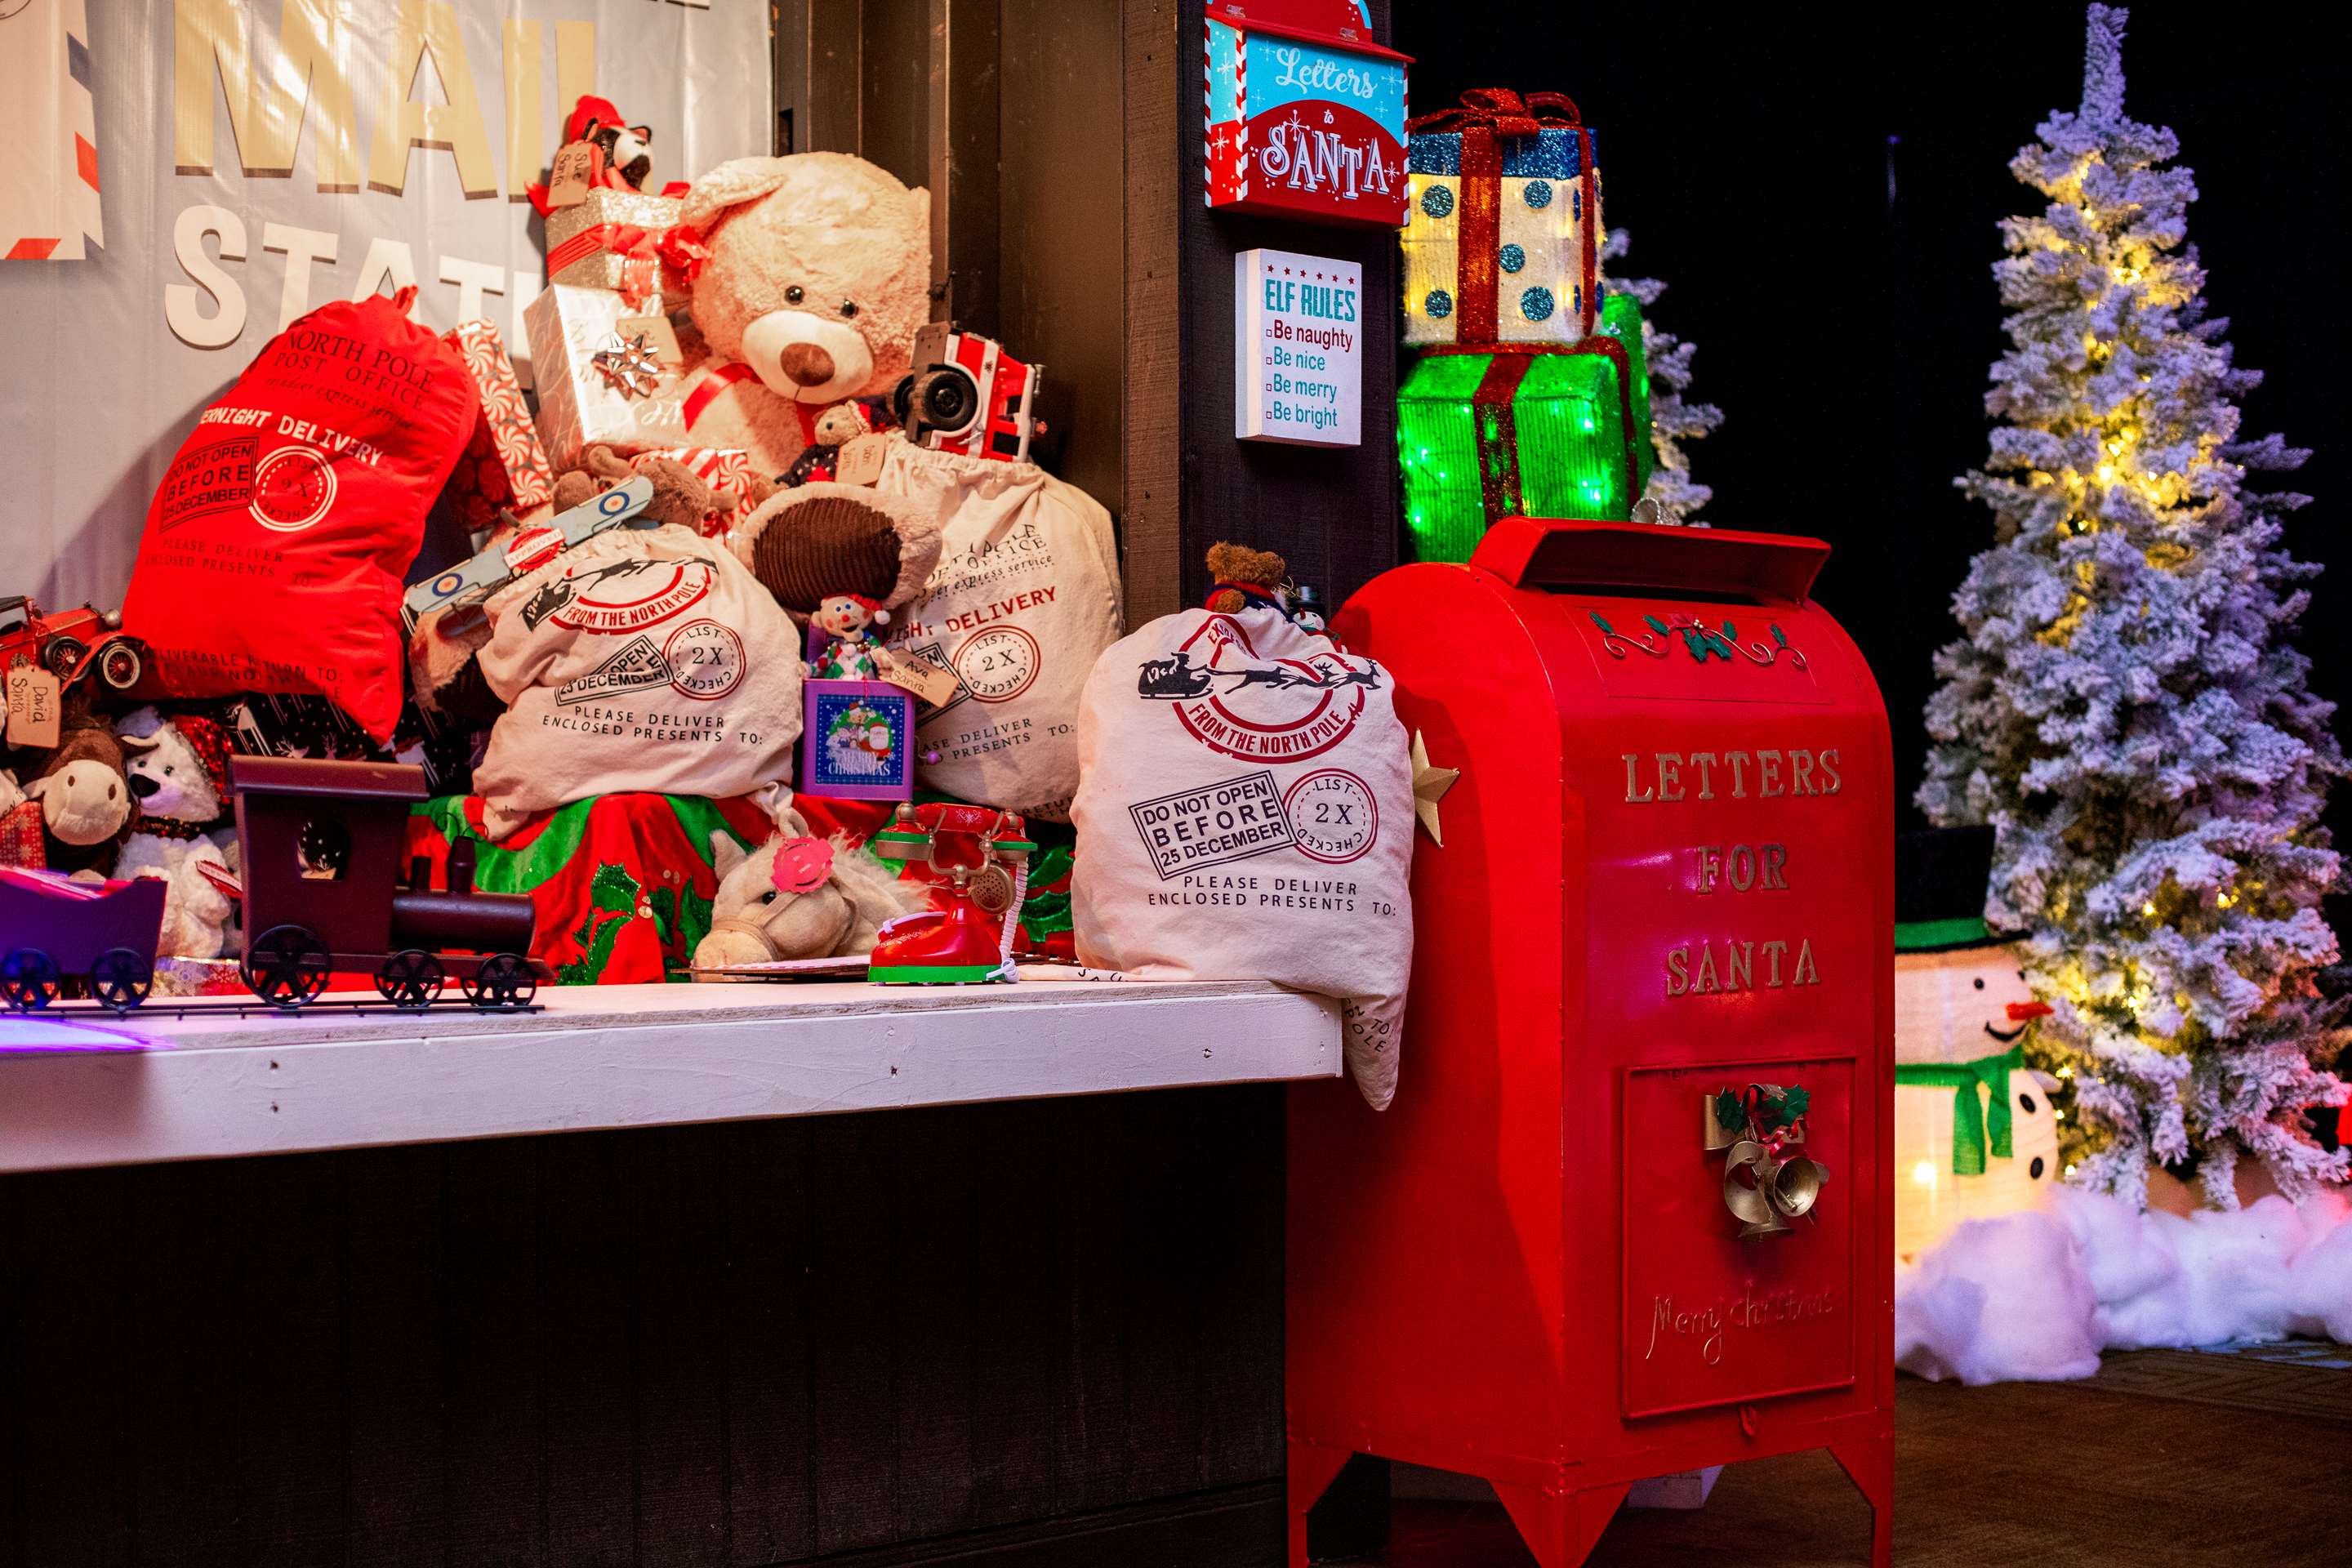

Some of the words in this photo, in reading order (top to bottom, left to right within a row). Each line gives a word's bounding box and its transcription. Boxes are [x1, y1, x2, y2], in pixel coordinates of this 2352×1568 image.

[1276, 47, 1378, 98] Letters
[1324, 109, 1334, 124] to
[1259, 125, 1389, 199] SANTA
[1266, 279, 1295, 313] ELF
[1301, 284, 1356, 322] RULES
[1274, 319, 1292, 341] Be
[1296, 327, 1352, 353] naughty
[283, 330, 366, 362] NORTH
[372, 349, 435, 394] POLE
[1274, 346, 1291, 366] Be
[1296, 350, 1325, 371] nice
[274, 352, 327, 372] POST
[345, 367, 423, 412] OFFICE
[1274, 373, 1290, 394] Be
[1295, 382, 1337, 403] merry
[1274, 401, 1291, 421] Be
[1295, 403, 1338, 430] bright
[277, 415, 385, 466] DELIVERY
[185, 452, 209, 471] NOT
[211, 444, 252, 463] OPEN
[167, 465, 249, 501] BEFORE
[175, 488, 250, 515] DECEMBER
[163, 537, 204, 552] PLEASE
[216, 544, 283, 563] DELIVER
[1008, 555, 1053, 573] service
[202, 559, 274, 577] PRESENTS
[563, 606, 596, 626] FROM
[601, 611, 626, 626] THE
[629, 599, 674, 624] NORTH
[674, 581, 700, 604] POLE
[946, 586, 1056, 632] DELIVERY
[686, 626, 720, 638] LIST
[976, 635, 1008, 649] LIST
[577, 670, 665, 691] DECEMBER
[676, 671, 731, 689] CHECKED
[905, 661, 928, 680] Ava
[973, 667, 1027, 693] CHECKED
[11, 678, 28, 715] Santa
[33, 686, 48, 723] David
[542, 715, 623, 735] ENCLOSED
[634, 727, 723, 742] PRESENTS
[740, 732, 763, 745] TO:
[575, 706, 634, 723] PLEASE
[648, 714, 724, 728] DELIVER
[960, 718, 1033, 744] DELIVER
[1188, 702, 1226, 741] FROM
[1227, 729, 1255, 753] THE
[1259, 732, 1312, 754] NORTH
[1310, 710, 1346, 744] POLE
[952, 733, 1031, 760] PRESENTS
[1048, 724, 1075, 737] TO:
[1314, 778, 1353, 794] LIST
[1622, 749, 1842, 803] LETTERS
[1143, 805, 1170, 826] DO
[1174, 795, 1211, 817] NOT
[1216, 780, 1268, 806] OPEN
[1152, 798, 1280, 848] BEFORE
[1160, 849, 1181, 867] 25
[1183, 821, 1285, 859] DECEMBER
[1297, 828, 1363, 852] CHECKED
[1697, 843, 1788, 893] FOR
[1184, 875, 1258, 890] PLEASE
[1275, 879, 1357, 896] DELIVER
[1149, 893, 1247, 906] ENCLOSED
[1260, 894, 1355, 912] PRESENTS
[1373, 902, 1396, 916] TO:
[1666, 938, 1821, 996] SANTA
[1646, 1294, 1722, 1365] Merry
